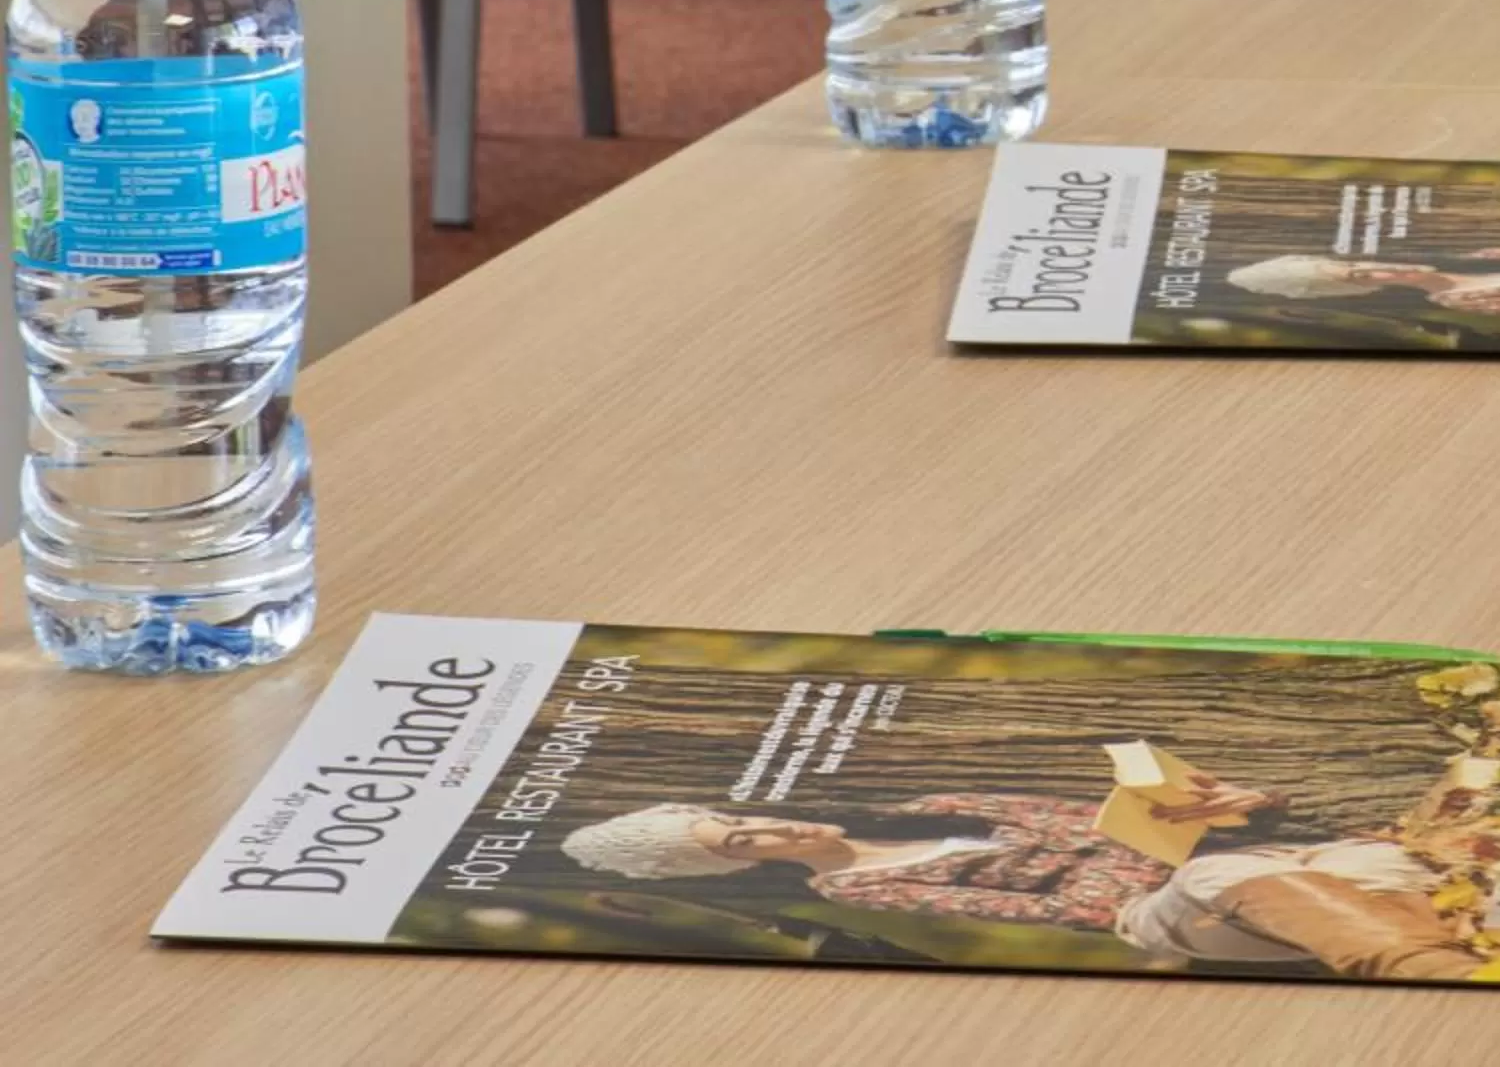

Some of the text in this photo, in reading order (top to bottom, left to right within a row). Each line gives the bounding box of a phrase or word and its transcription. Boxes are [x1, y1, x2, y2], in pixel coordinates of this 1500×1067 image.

[987, 170, 1112, 313] Brocéliande
[1152, 168, 1219, 310] HÔTEL RESTAURANT SPA
[220, 657, 496, 894] Brocéliande
[240, 802, 296, 847] Relais
[446, 653, 640, 892] HÔTEL RESTAURANT SPA
